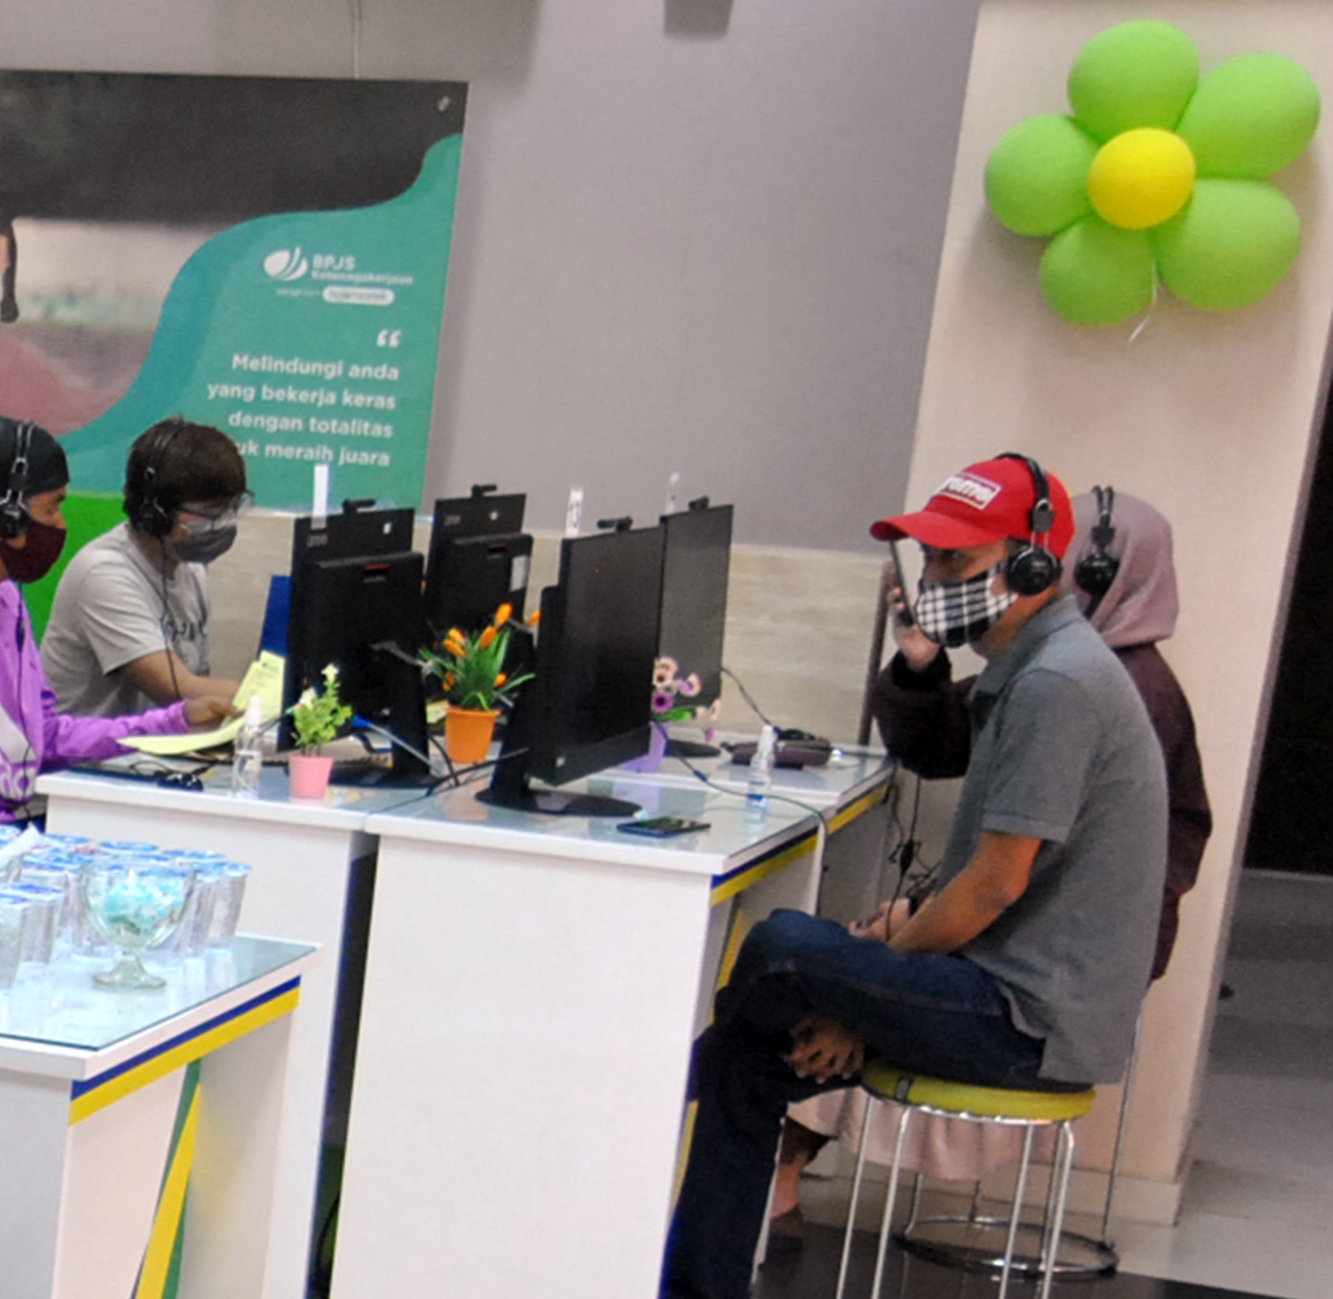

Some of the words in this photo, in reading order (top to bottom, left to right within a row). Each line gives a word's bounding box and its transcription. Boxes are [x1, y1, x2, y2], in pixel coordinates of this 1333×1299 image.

[313, 254, 356, 271] BPJS
[232, 354, 343, 379] Melindungi
[348, 364, 400, 381] anda
[207, 382, 256, 403] yang
[261, 384, 336, 408] bekerja
[342, 389, 396, 411] keras
[229, 410, 303, 434] dengan
[309, 416, 394, 439] totalitas
[264, 443, 333, 462] meraih
[338, 447, 391, 467] juara
